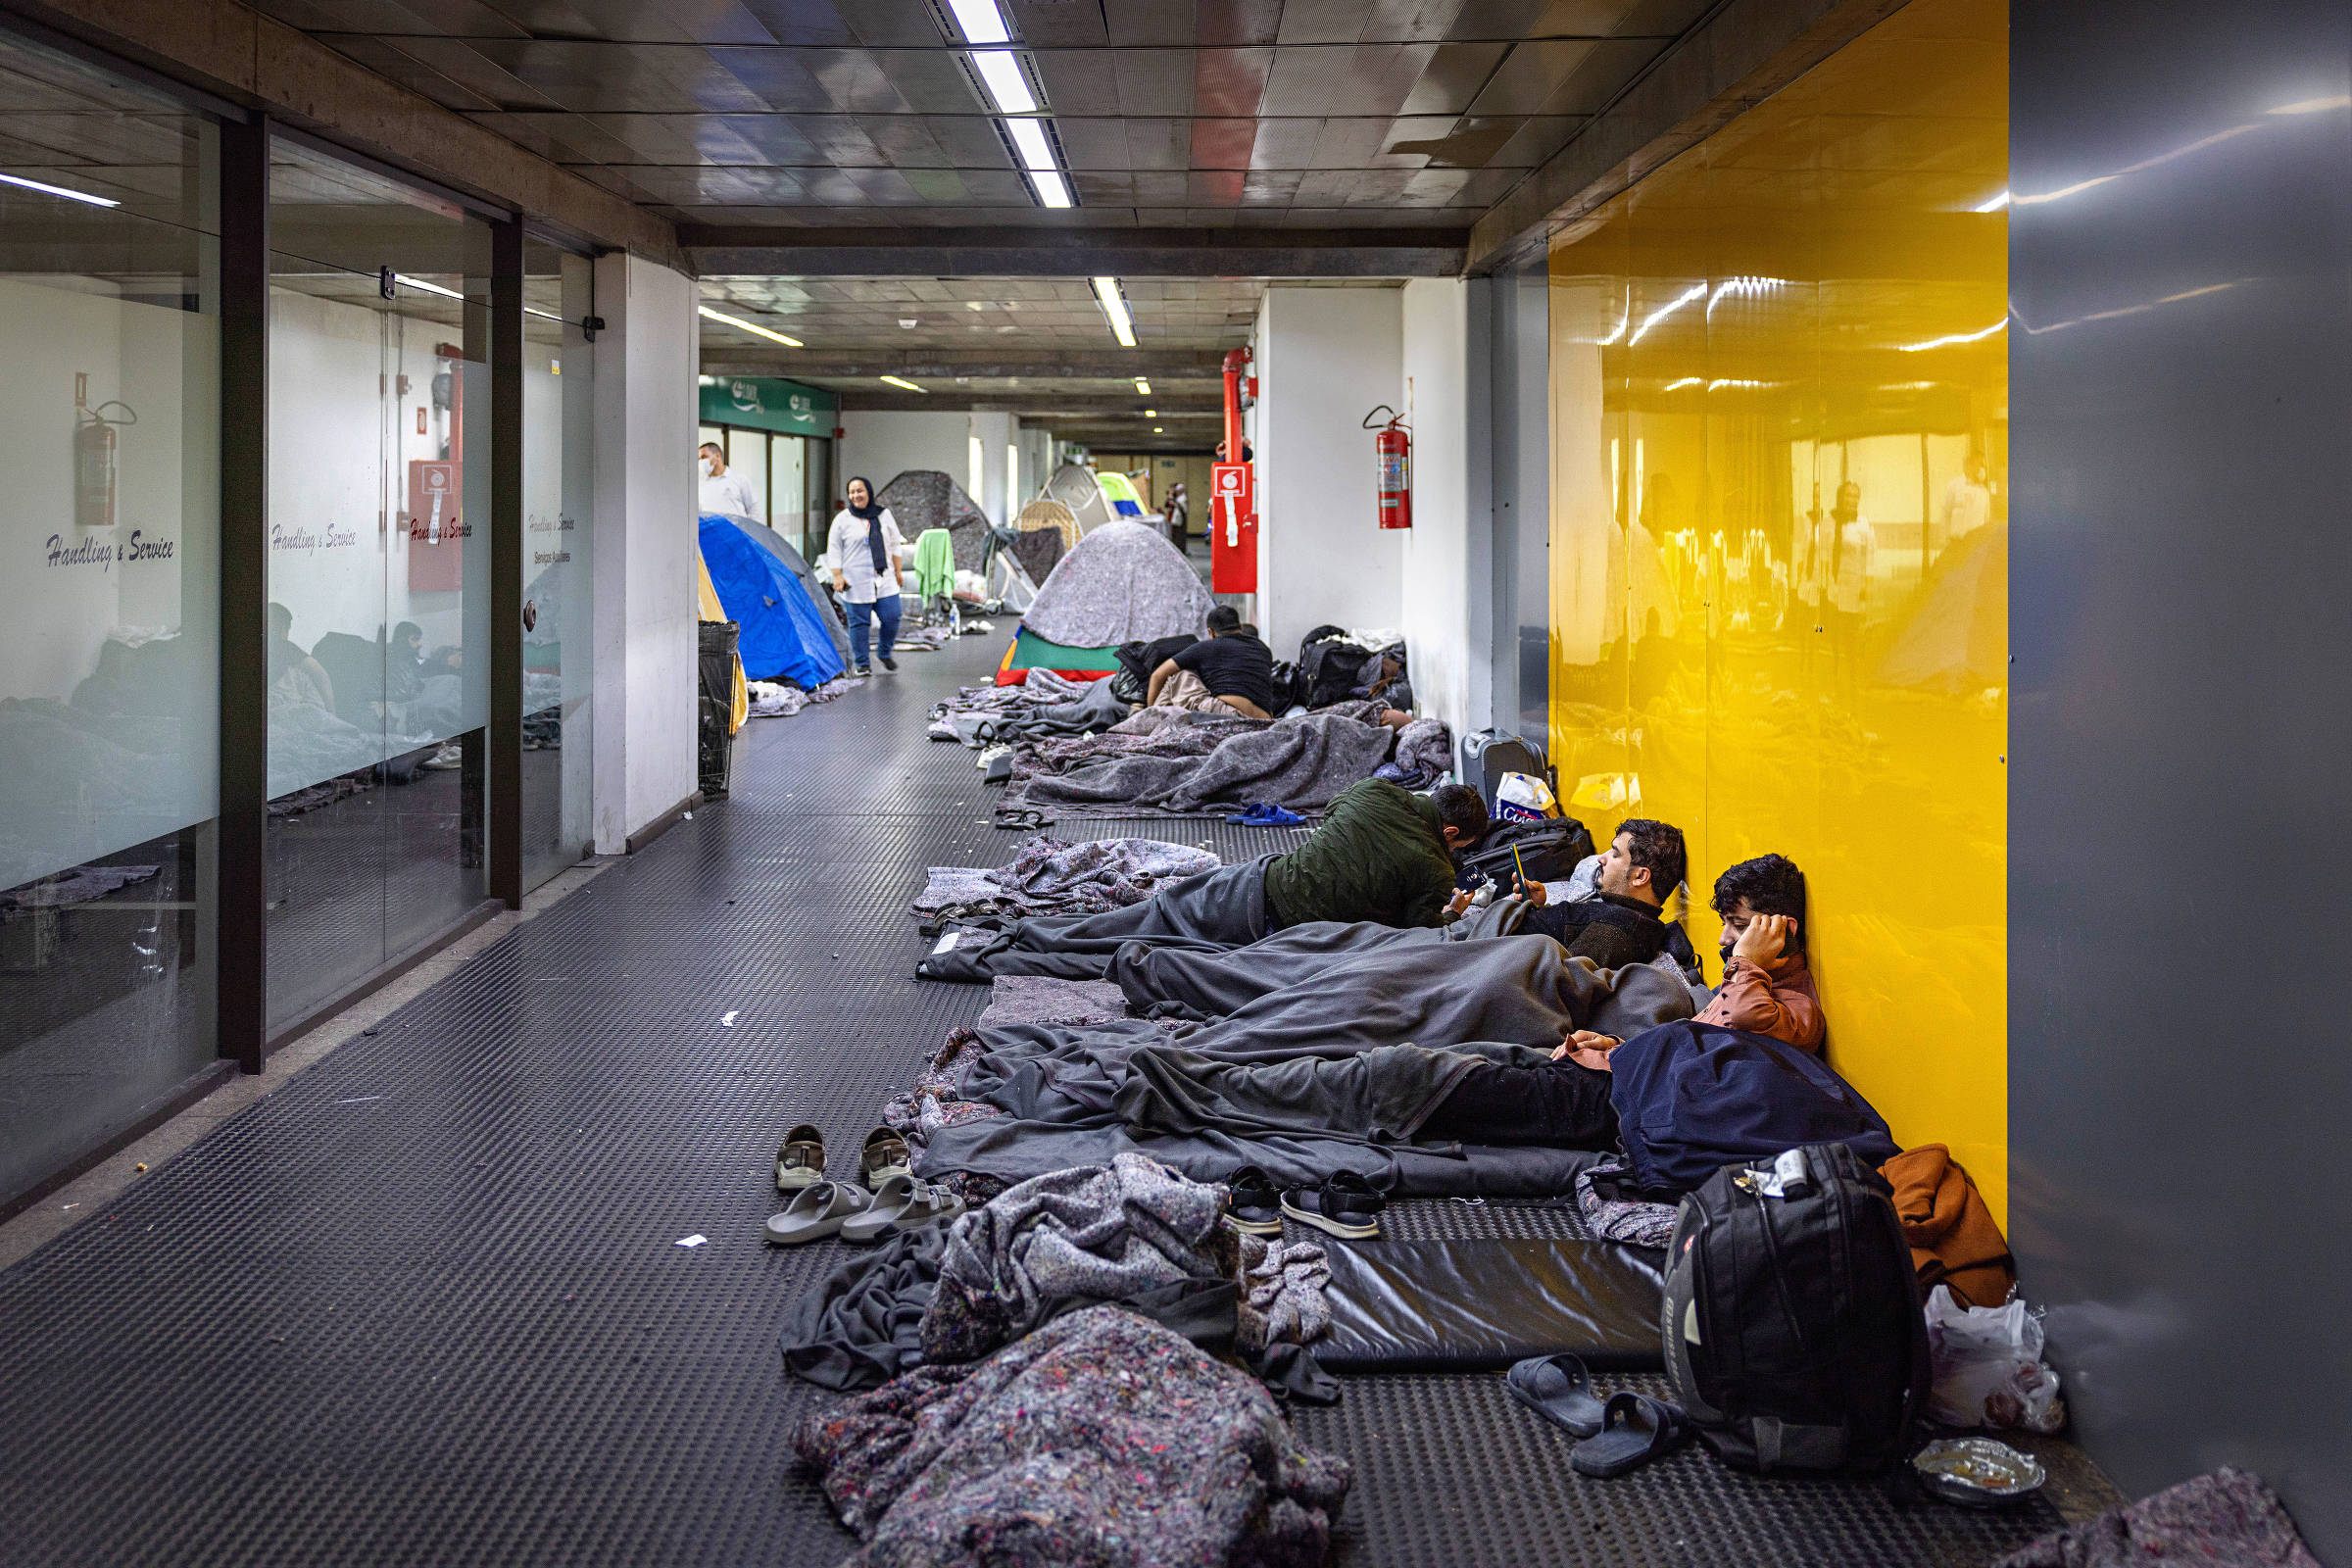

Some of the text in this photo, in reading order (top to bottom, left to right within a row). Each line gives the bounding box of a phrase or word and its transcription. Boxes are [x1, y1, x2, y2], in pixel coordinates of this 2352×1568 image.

[271, 523, 315, 557] Handling
[325, 522, 357, 548] Service
[410, 517, 441, 547] Handling
[449, 516, 472, 539] Service
[46, 529, 173, 572] Handling & Service
